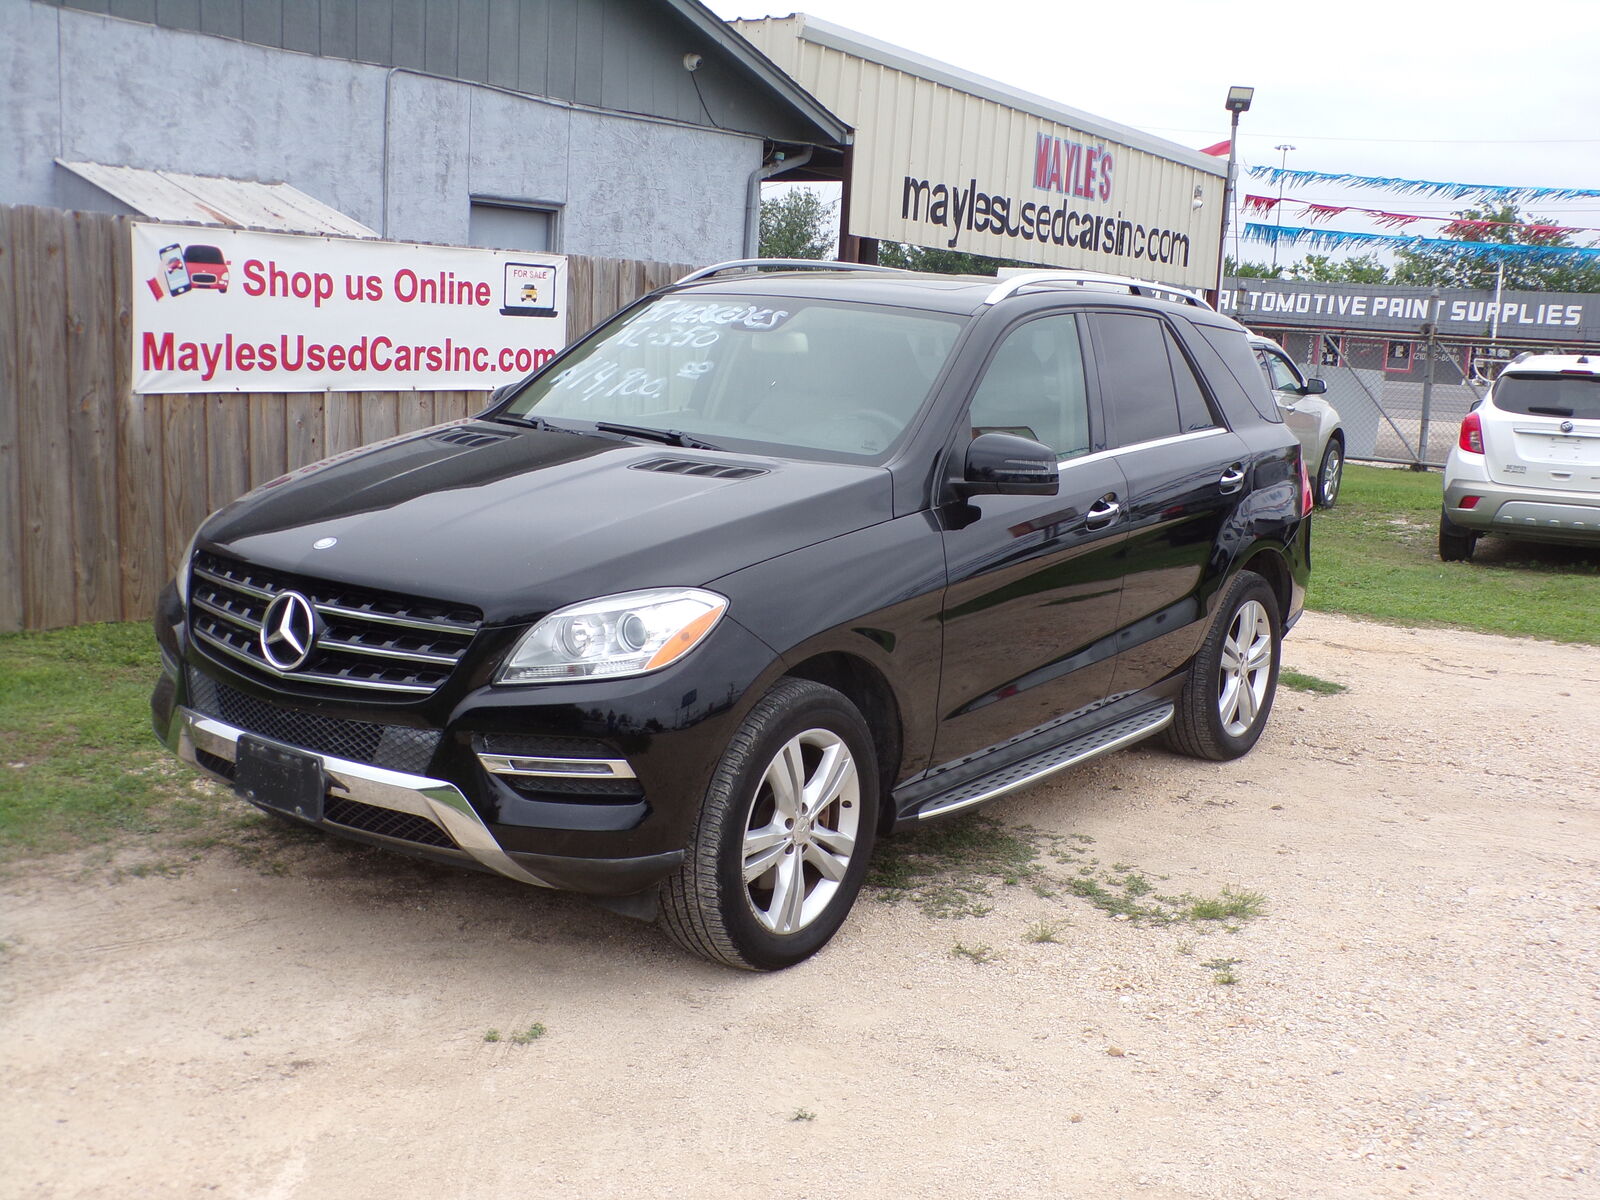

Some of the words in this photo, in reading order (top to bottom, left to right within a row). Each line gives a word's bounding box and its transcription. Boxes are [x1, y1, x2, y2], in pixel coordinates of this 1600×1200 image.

[1033, 131, 1114, 204] MAYLE'S
[901, 176, 1190, 268] maylesusedcarsinccom
[242, 259, 334, 308] Shop
[345, 274, 384, 303] us
[393, 268, 492, 307] Online
[513, 269, 528, 278] FOR
[530, 270, 548, 280] SALE
[1450, 300, 1583, 326] SUPPLIES
[142, 331, 557, 381] MaylesUsedCarsInc.com
